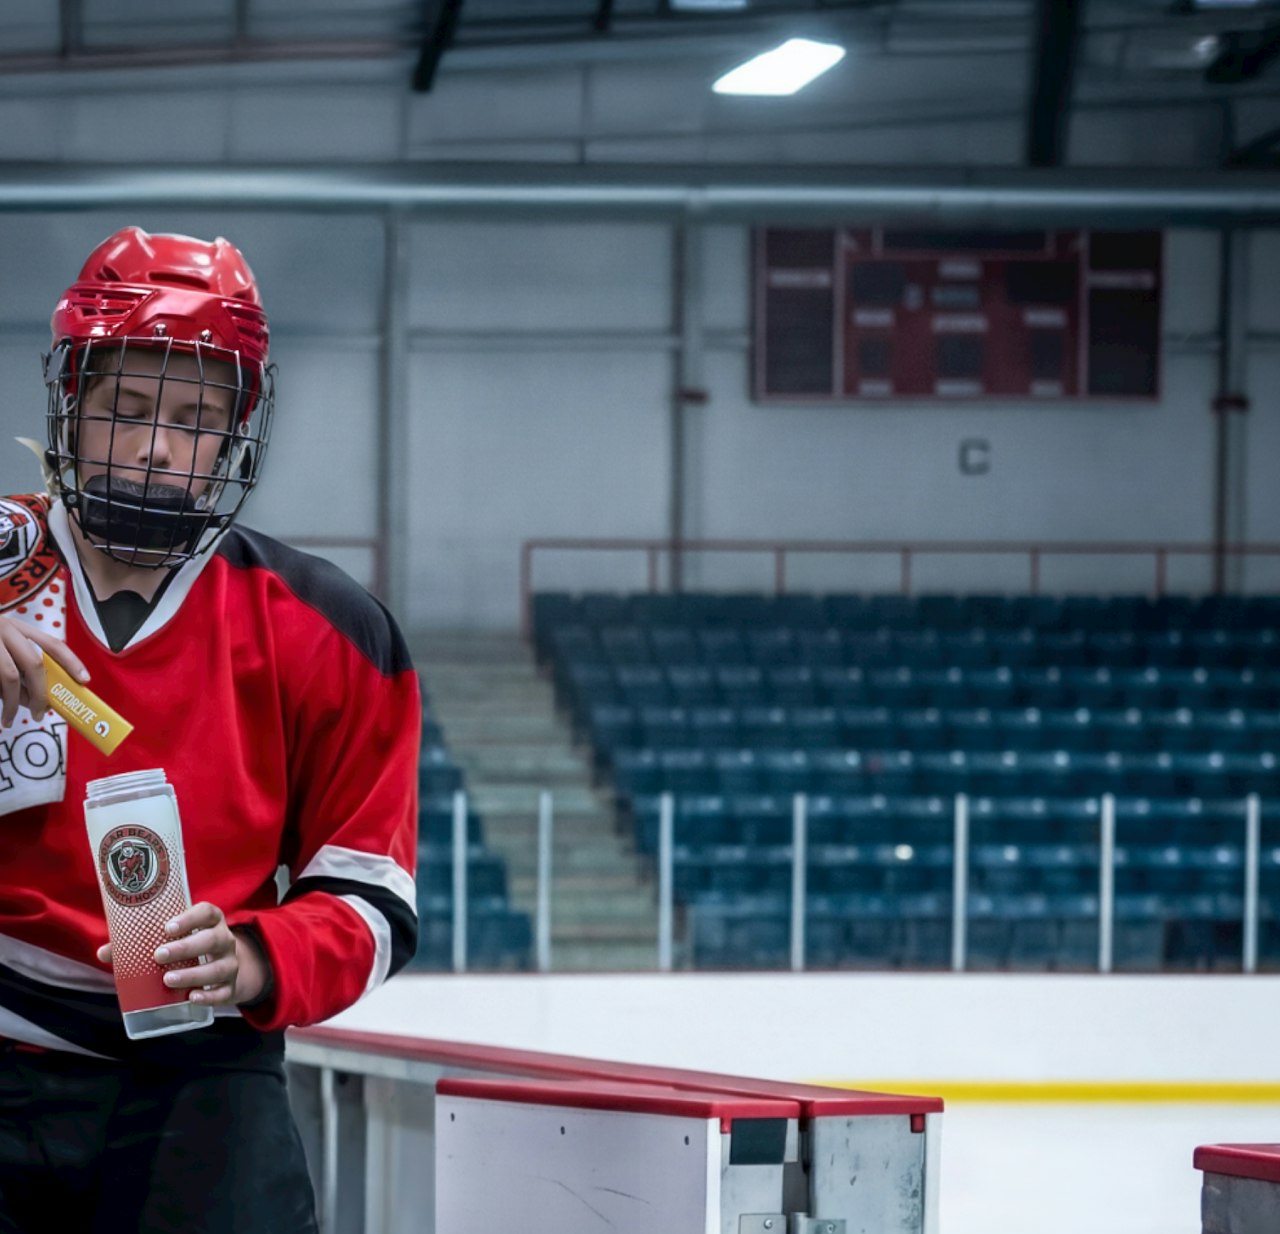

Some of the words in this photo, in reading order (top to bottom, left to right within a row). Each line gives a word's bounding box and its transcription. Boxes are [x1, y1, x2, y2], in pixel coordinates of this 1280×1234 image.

[50, 683, 98, 724] GATORLYTE
[101, 830, 124, 864] POLAR
[128, 827, 164, 854] BEARS
